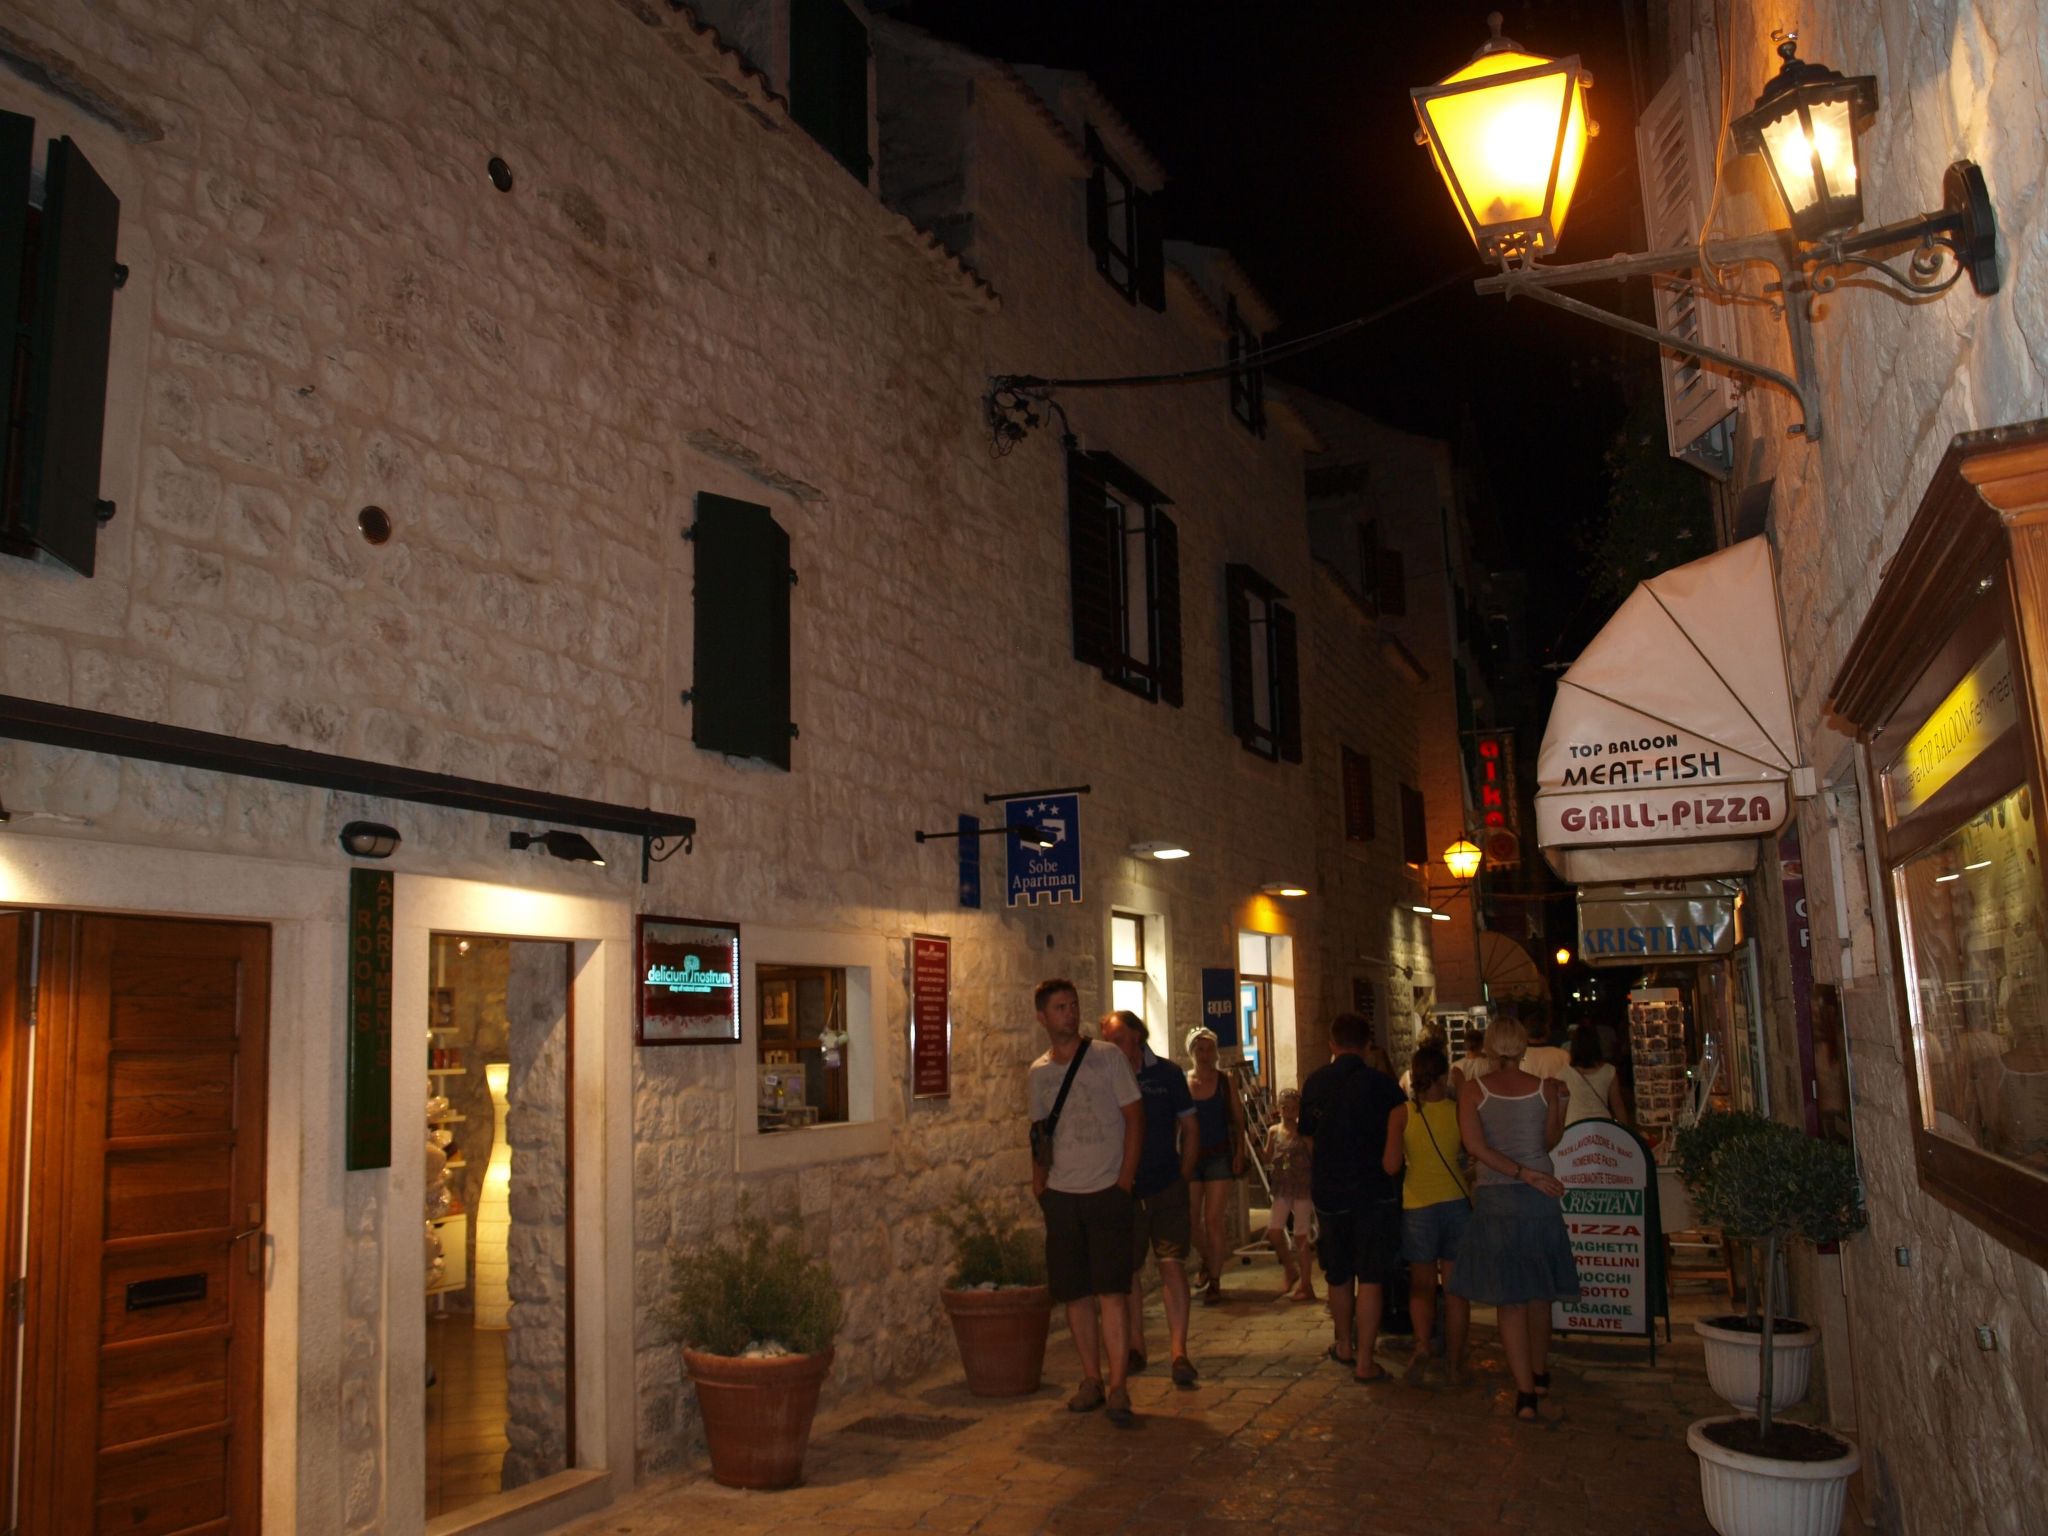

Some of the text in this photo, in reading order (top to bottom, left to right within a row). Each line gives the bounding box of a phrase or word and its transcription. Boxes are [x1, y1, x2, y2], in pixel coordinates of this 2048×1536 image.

[1570, 735, 1678, 759] TOP BALOON
[1561, 752, 1721, 787] MEAT-FISH
[1560, 795, 1771, 833] GRILL-PIZZA
[1028, 858, 1059, 875] Sobe
[1012, 873, 1077, 893] Apartman
[375, 876, 391, 1068] APARTMENTS
[648, 964, 731, 984] delicium nostrum
[1207, 1000, 1233, 1018] aqua
[1567, 1223, 1641, 1237] IZZA
[1570, 1241, 1639, 1253] PAGHETTI
[1574, 1255, 1640, 1268] RTELLINI
[1576, 1272, 1631, 1284] NOCCHI
[1579, 1286, 1629, 1298] SOTTO
[1562, 1302, 1633, 1316] LASAGNE
[1568, 1316, 1623, 1329] SALATE
